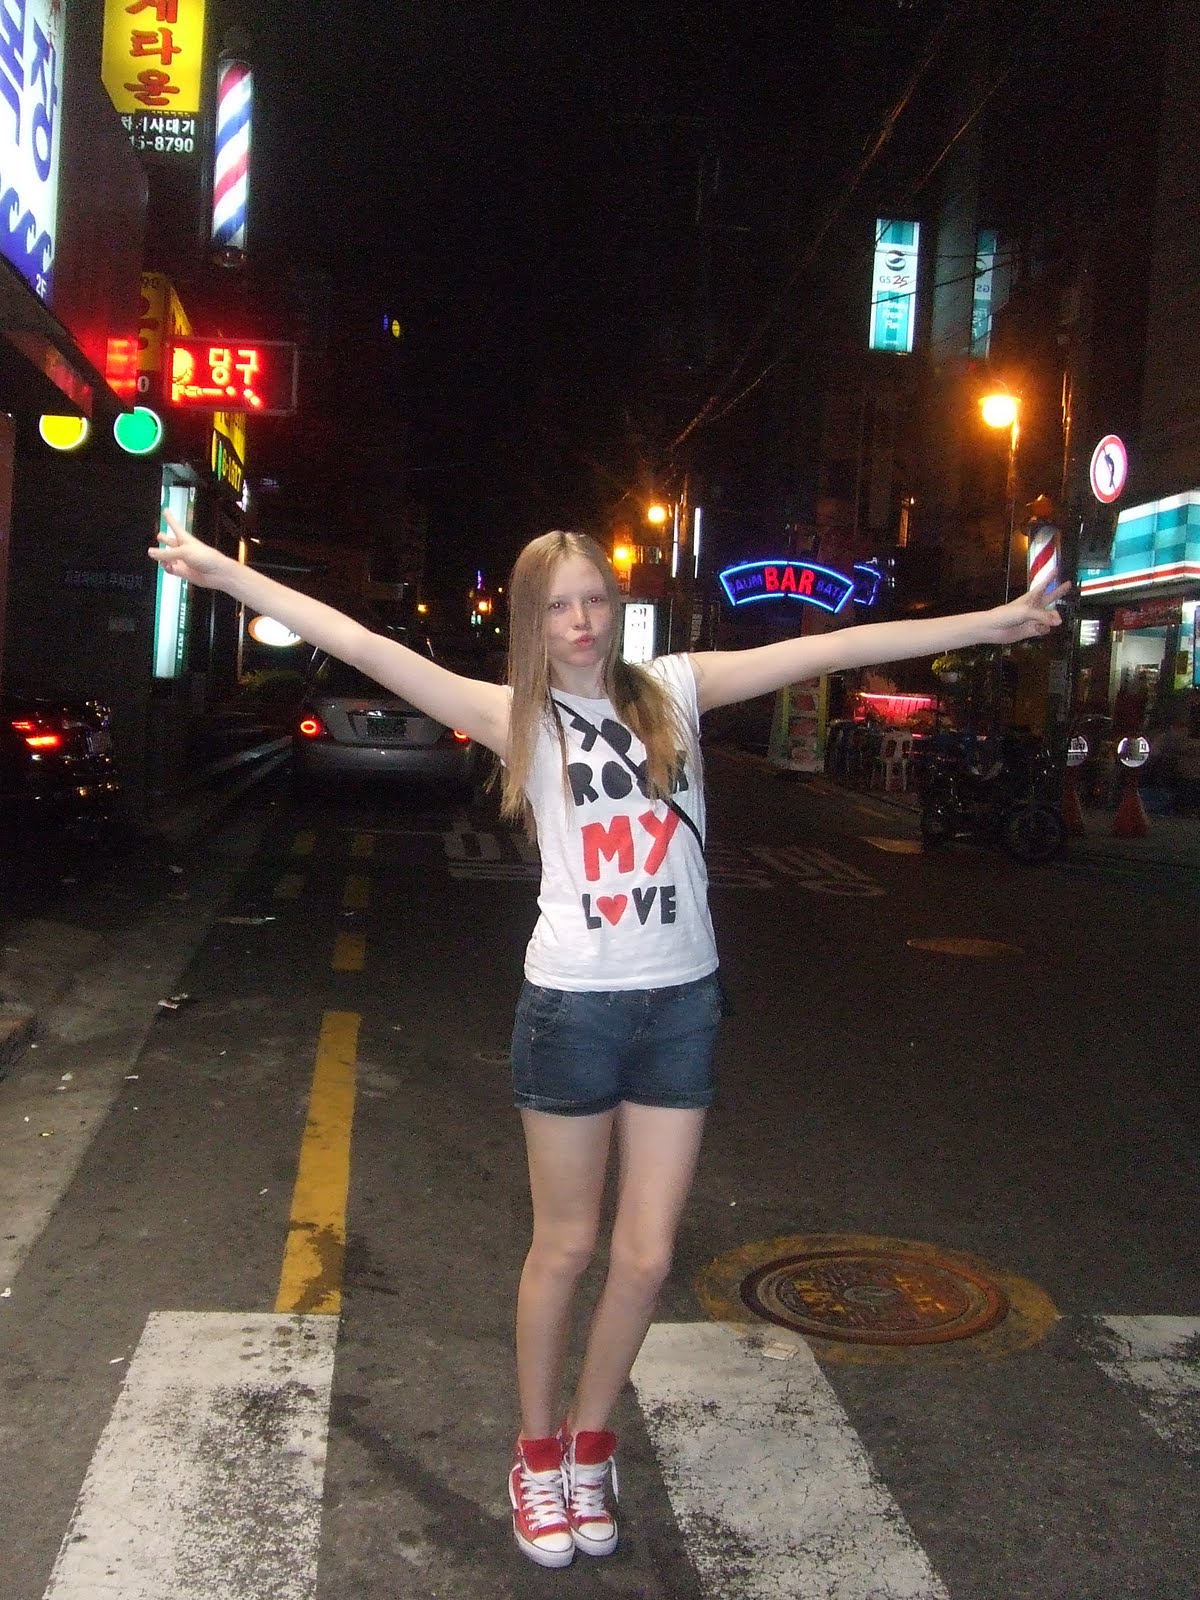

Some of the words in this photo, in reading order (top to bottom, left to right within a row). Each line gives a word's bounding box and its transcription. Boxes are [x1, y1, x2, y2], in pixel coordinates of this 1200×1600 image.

[879, 275, 892, 284] GS
[893, 274, 910, 288] 25
[764, 566, 815, 595] BAR
[581, 809, 680, 882] MY
